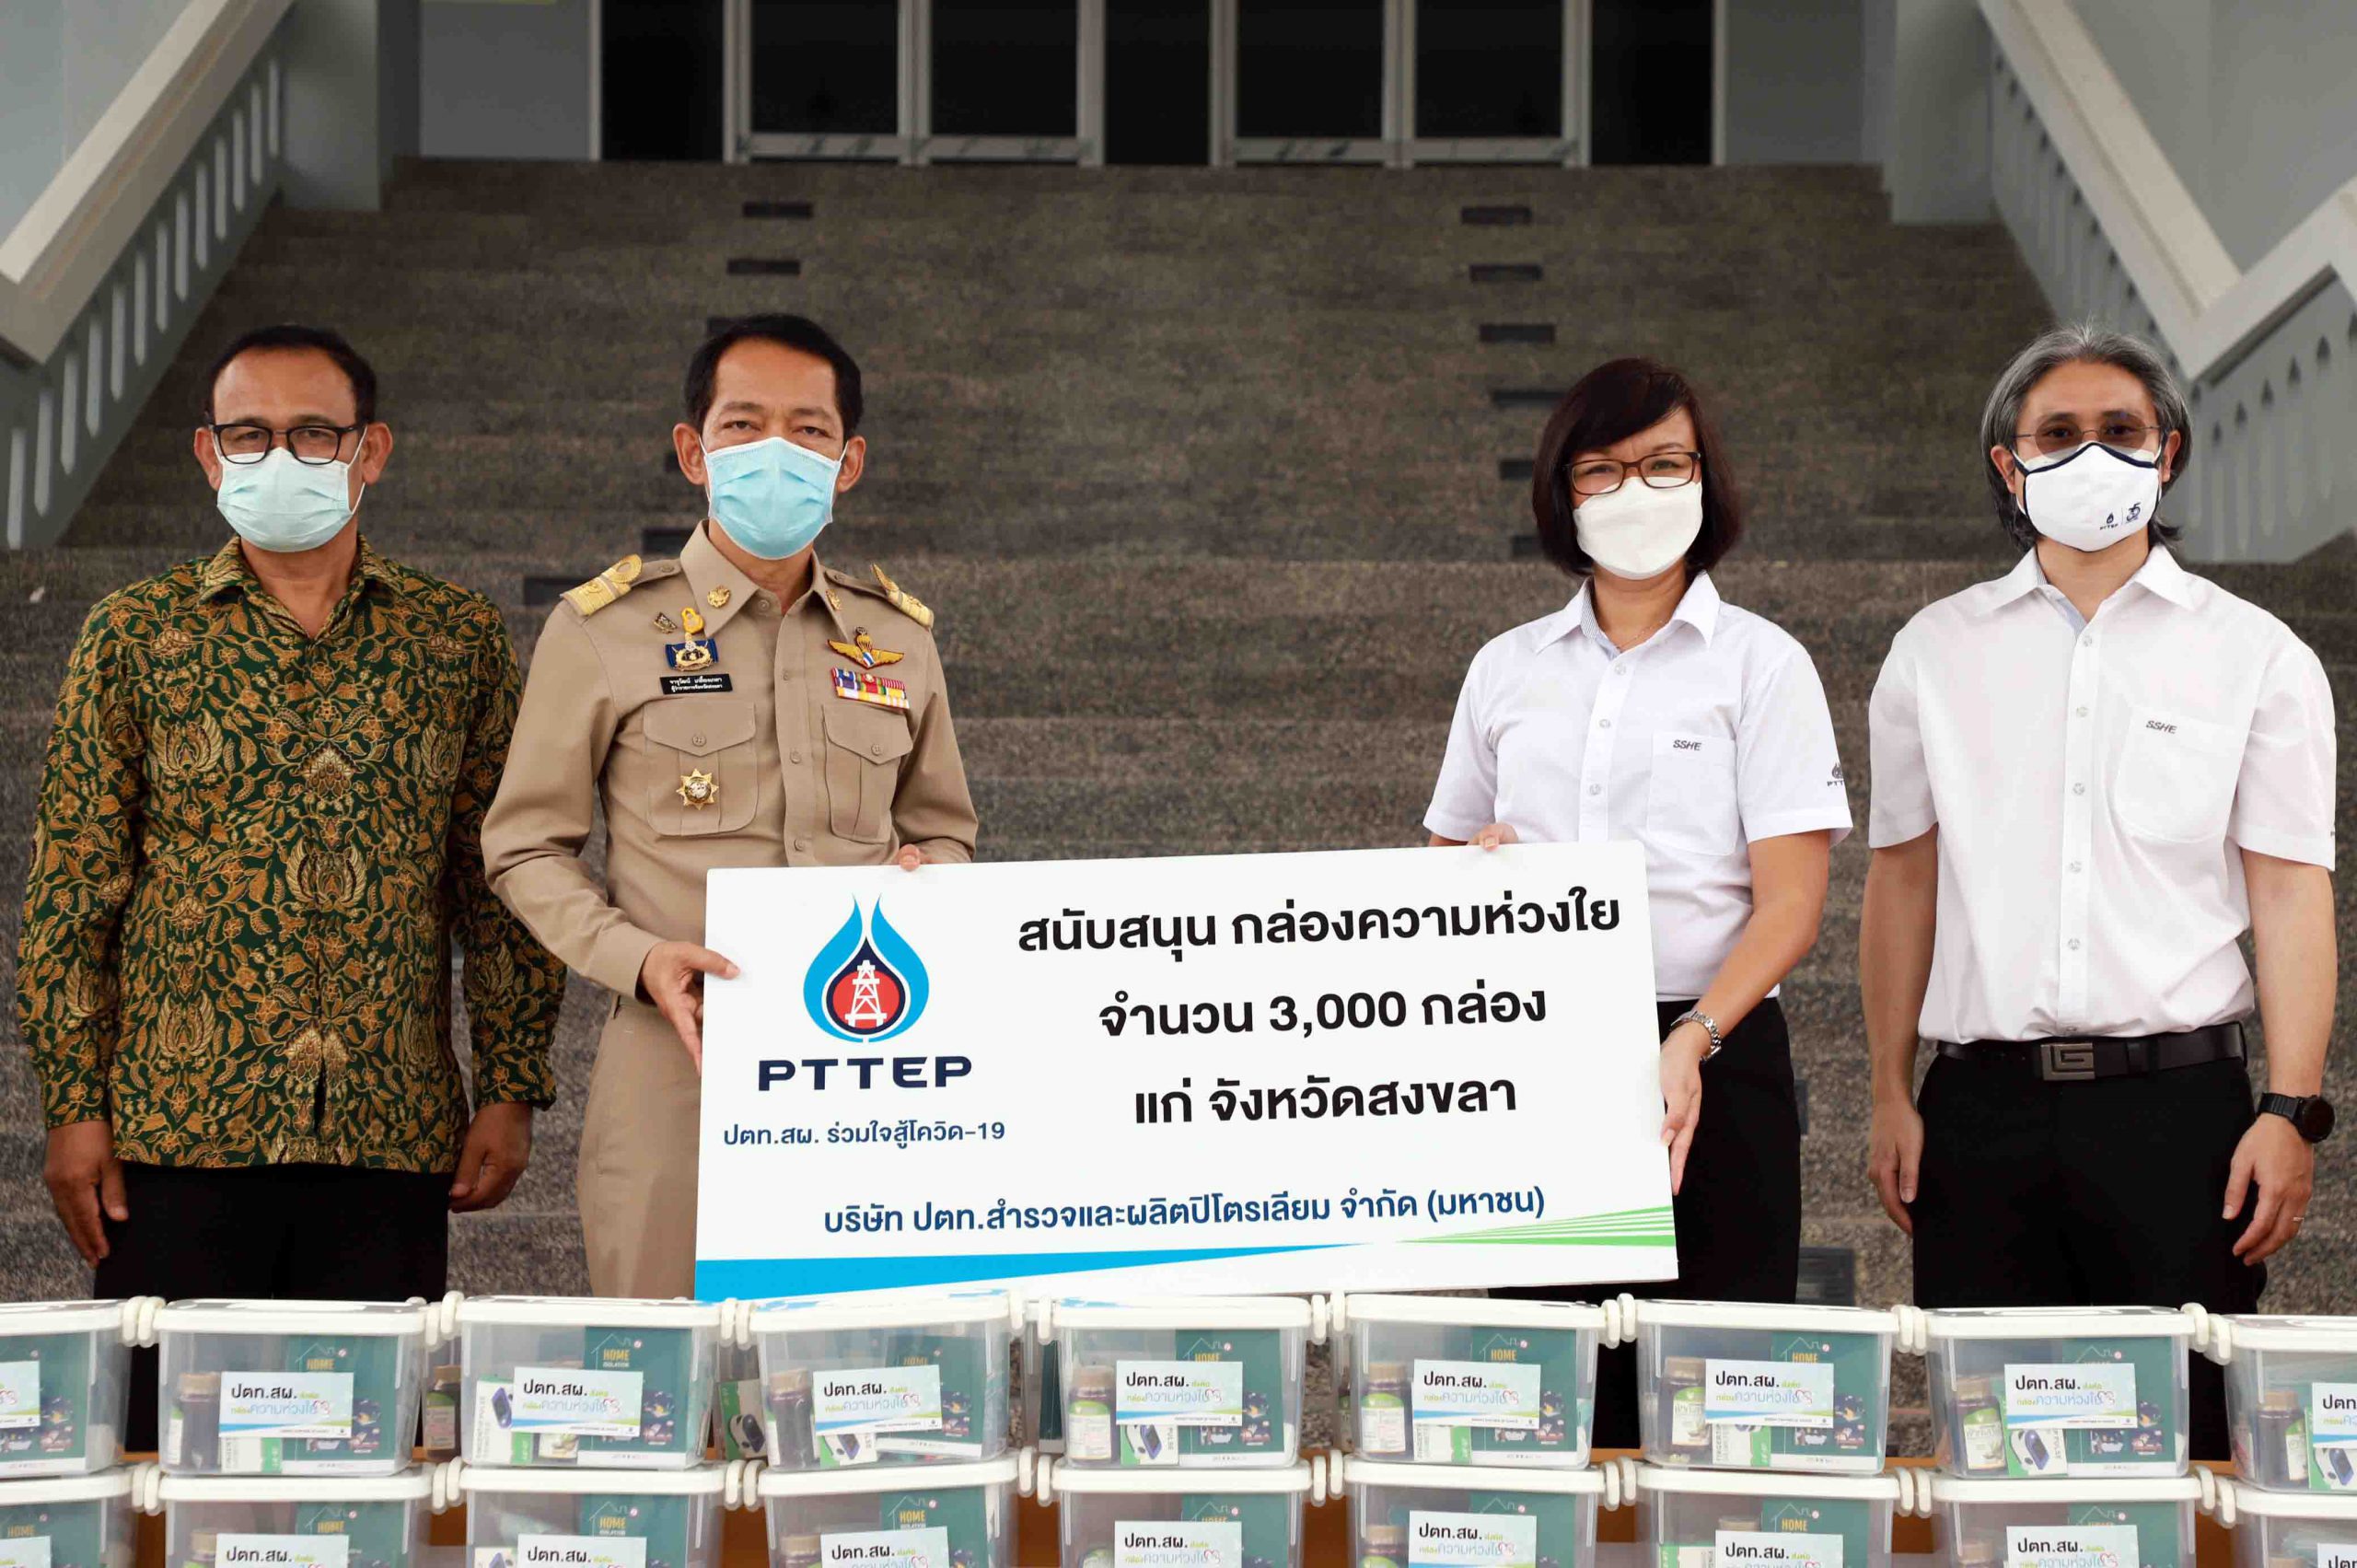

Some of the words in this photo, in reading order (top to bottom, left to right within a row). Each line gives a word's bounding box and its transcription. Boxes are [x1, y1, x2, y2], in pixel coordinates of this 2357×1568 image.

[2146, 720, 2177, 735] SSHE
[1673, 739, 1701, 751] SSHE
[1018, 908, 1216, 963] สนับสนุน
[1231, 886, 1620, 945] กล่องความห่วงใย
[1098, 990, 1254, 1037] จำนวน
[1269, 992, 1407, 1039] 3,000
[1421, 978, 1547, 1026] กล่อง
[758, 1055, 972, 1092] PTTEP
[1135, 1076, 1192, 1124] แก่
[1208, 1074, 1516, 1121] จังหวัดสงขลา
[724, 1123, 819, 1145] ปตท.สผ.
[827, 1120, 1005, 1150] ร่วมใจสู้โควิด-19
[824, 1202, 903, 1234] บริษัท
[913, 1191, 1330, 1231] ปตท.สำรวจและผลิตปิโตรเลียม
[1340, 1187, 1418, 1219] จำกัด
[1427, 1186, 1545, 1223] (มหาชน)
[603, 1349, 630, 1361] HOME
[1491, 1349, 1517, 1361] HOME
[1792, 1352, 1818, 1363] HOME
[1126, 1372, 1190, 1388] ปตท.สผ.
[1423, 1371, 1487, 1388] ปตท.สผ.
[1715, 1370, 1780, 1388] ปตท.สผ.
[2015, 1375, 2081, 1390] ปตท.สผ.
[232, 1384, 297, 1399] ปตท.สผ.
[524, 1379, 587, 1397] ปตท.สผ.
[824, 1382, 887, 1397] ปตท.สผ.
[599, 1516, 626, 1529] HOME
[900, 1510, 925, 1523] HOME
[1419, 1522, 1482, 1539] ปตท.สผ.
[1782, 1518, 1808, 1532] HOME
[1124, 1532, 1188, 1549] ปตท.สผ.
[2017, 1538, 2084, 1553] ปตท.สผ.
[226, 1547, 293, 1562] ปตท.สผ.
[528, 1546, 591, 1562] ปตท.สผ.
[831, 1544, 895, 1560] ปตท.สผ.
[1725, 1542, 1789, 1560] ปตท.สผ.
